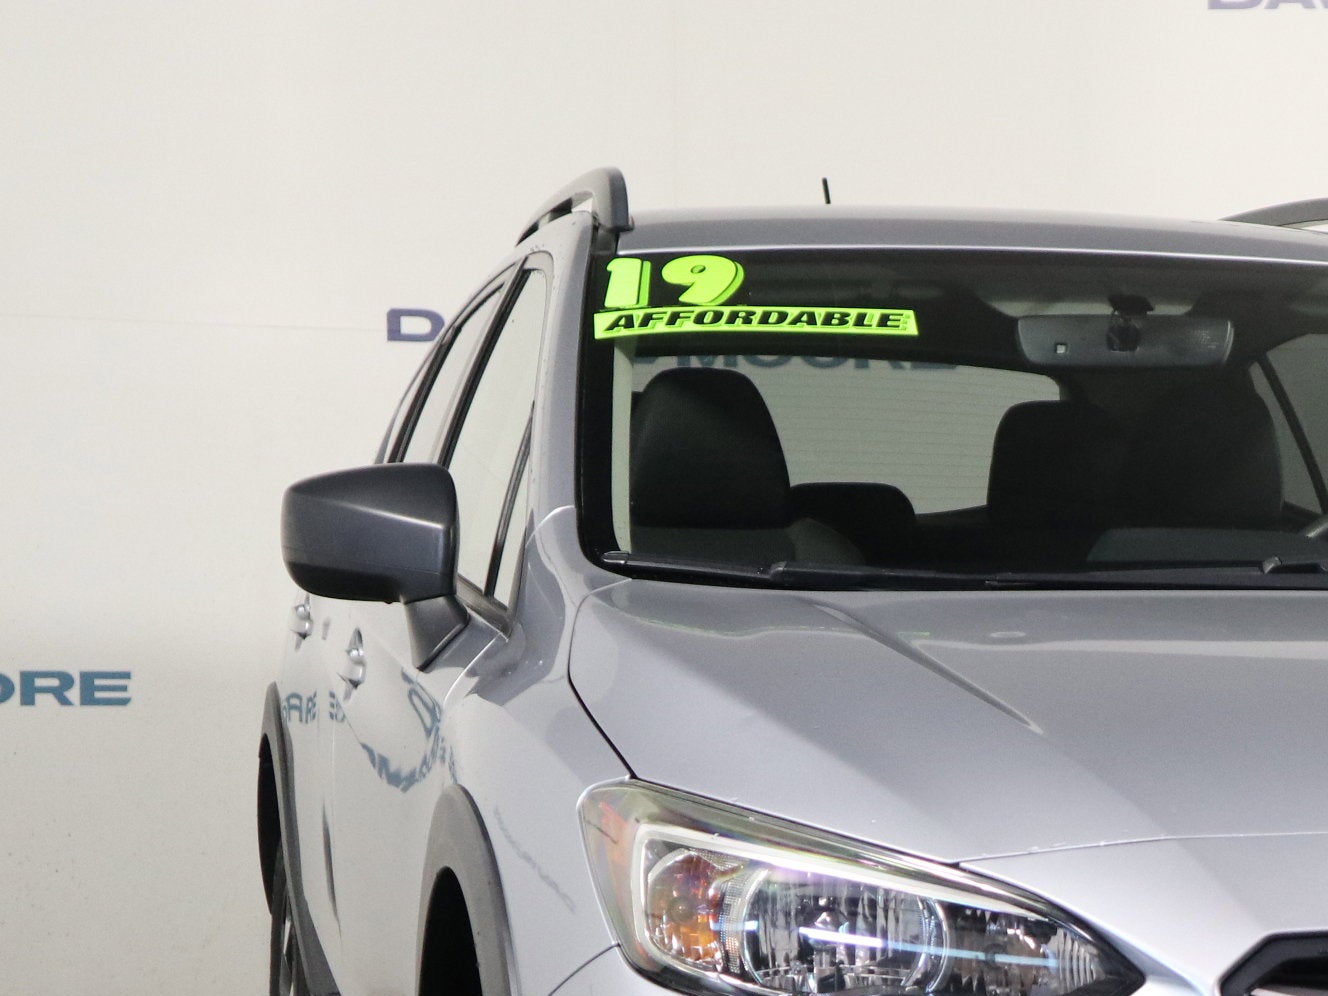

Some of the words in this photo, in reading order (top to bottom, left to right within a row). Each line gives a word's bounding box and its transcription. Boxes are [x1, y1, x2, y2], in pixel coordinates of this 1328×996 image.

[604, 254, 745, 308] 19
[603, 308, 908, 331] AFFORDABLE
[0, 670, 132, 706] RE
